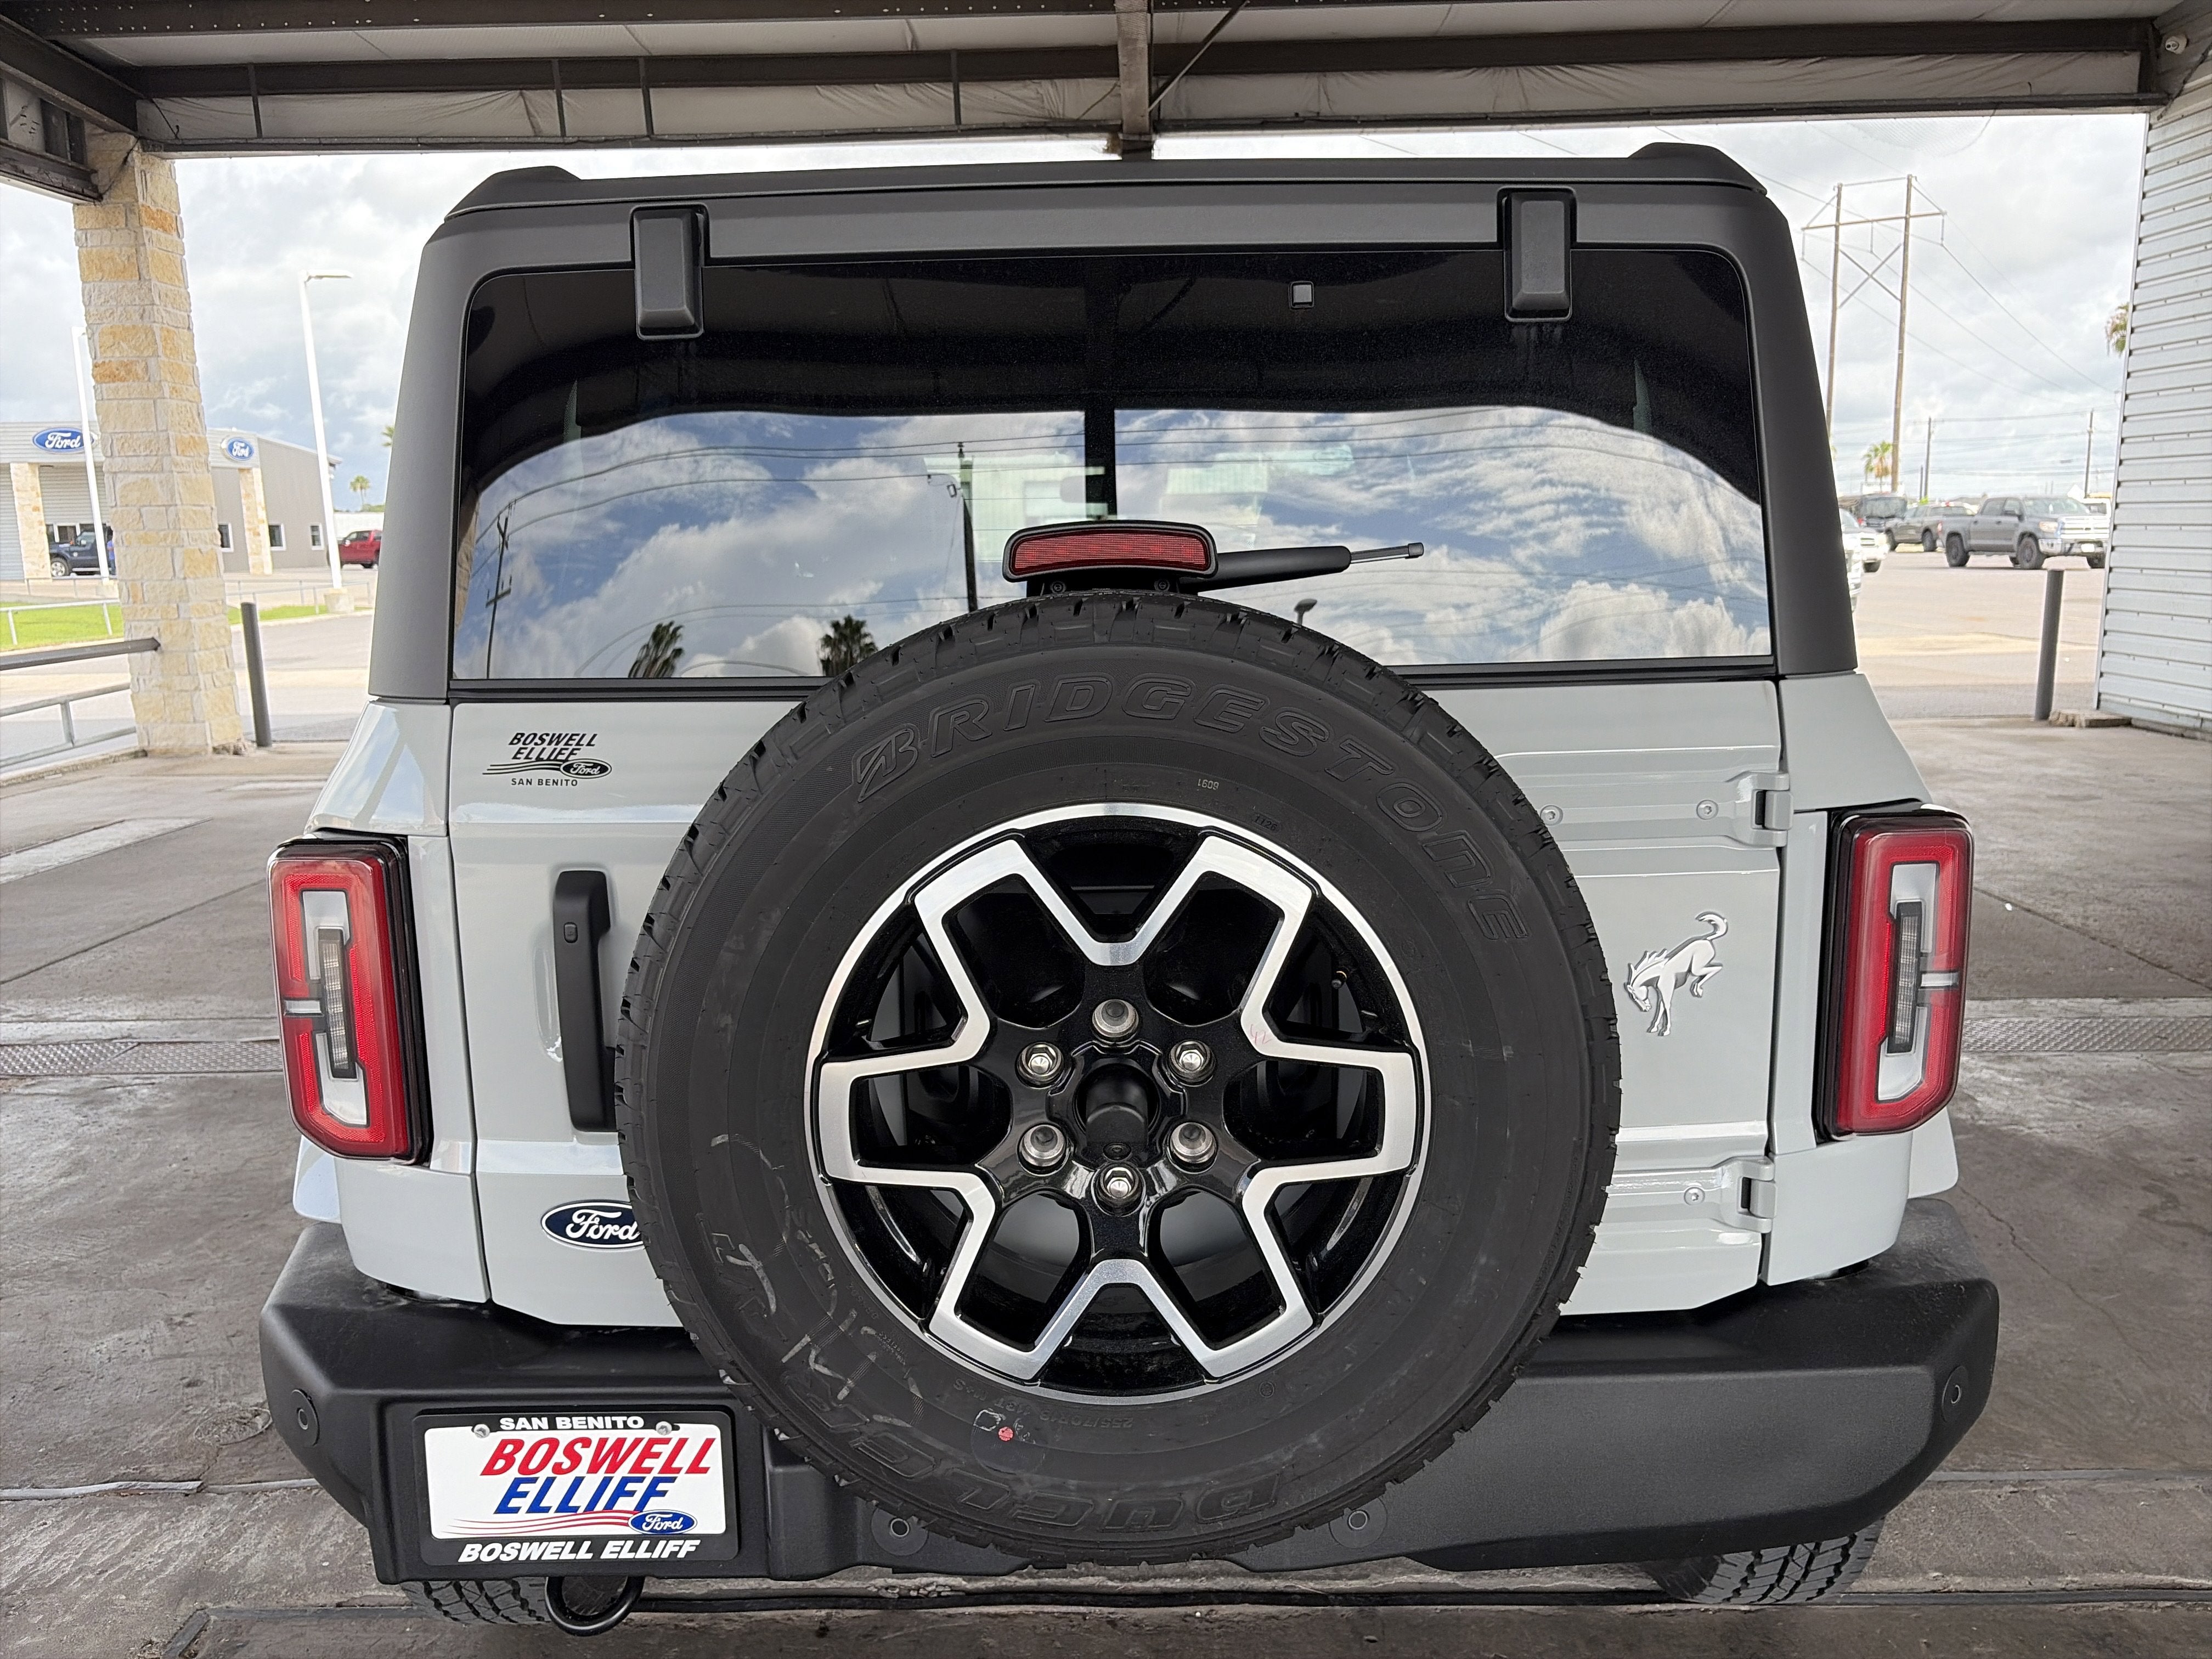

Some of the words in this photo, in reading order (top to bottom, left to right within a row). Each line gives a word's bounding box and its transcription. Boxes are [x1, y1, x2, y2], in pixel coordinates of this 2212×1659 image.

[44, 431, 81, 448] Ford
[232, 441, 250, 457] Ford
[509, 732, 597, 746] BOSWELL
[511, 747, 582, 761] ELLIFF
[569, 762, 601, 775] Ford
[854, 673, 1530, 940] BRIDGESTONE
[566, 1209, 641, 1240] Ford
[499, 1417, 549, 1431] SAN
[556, 1416, 645, 1430] BENITO
[479, 1436, 716, 1476] BOSWELL
[493, 1476, 678, 1514] ELLIFF
[642, 1513, 685, 1530] Ford
[458, 1540, 594, 1562] BOSWELL
[600, 1539, 702, 1560] ELLIFF
